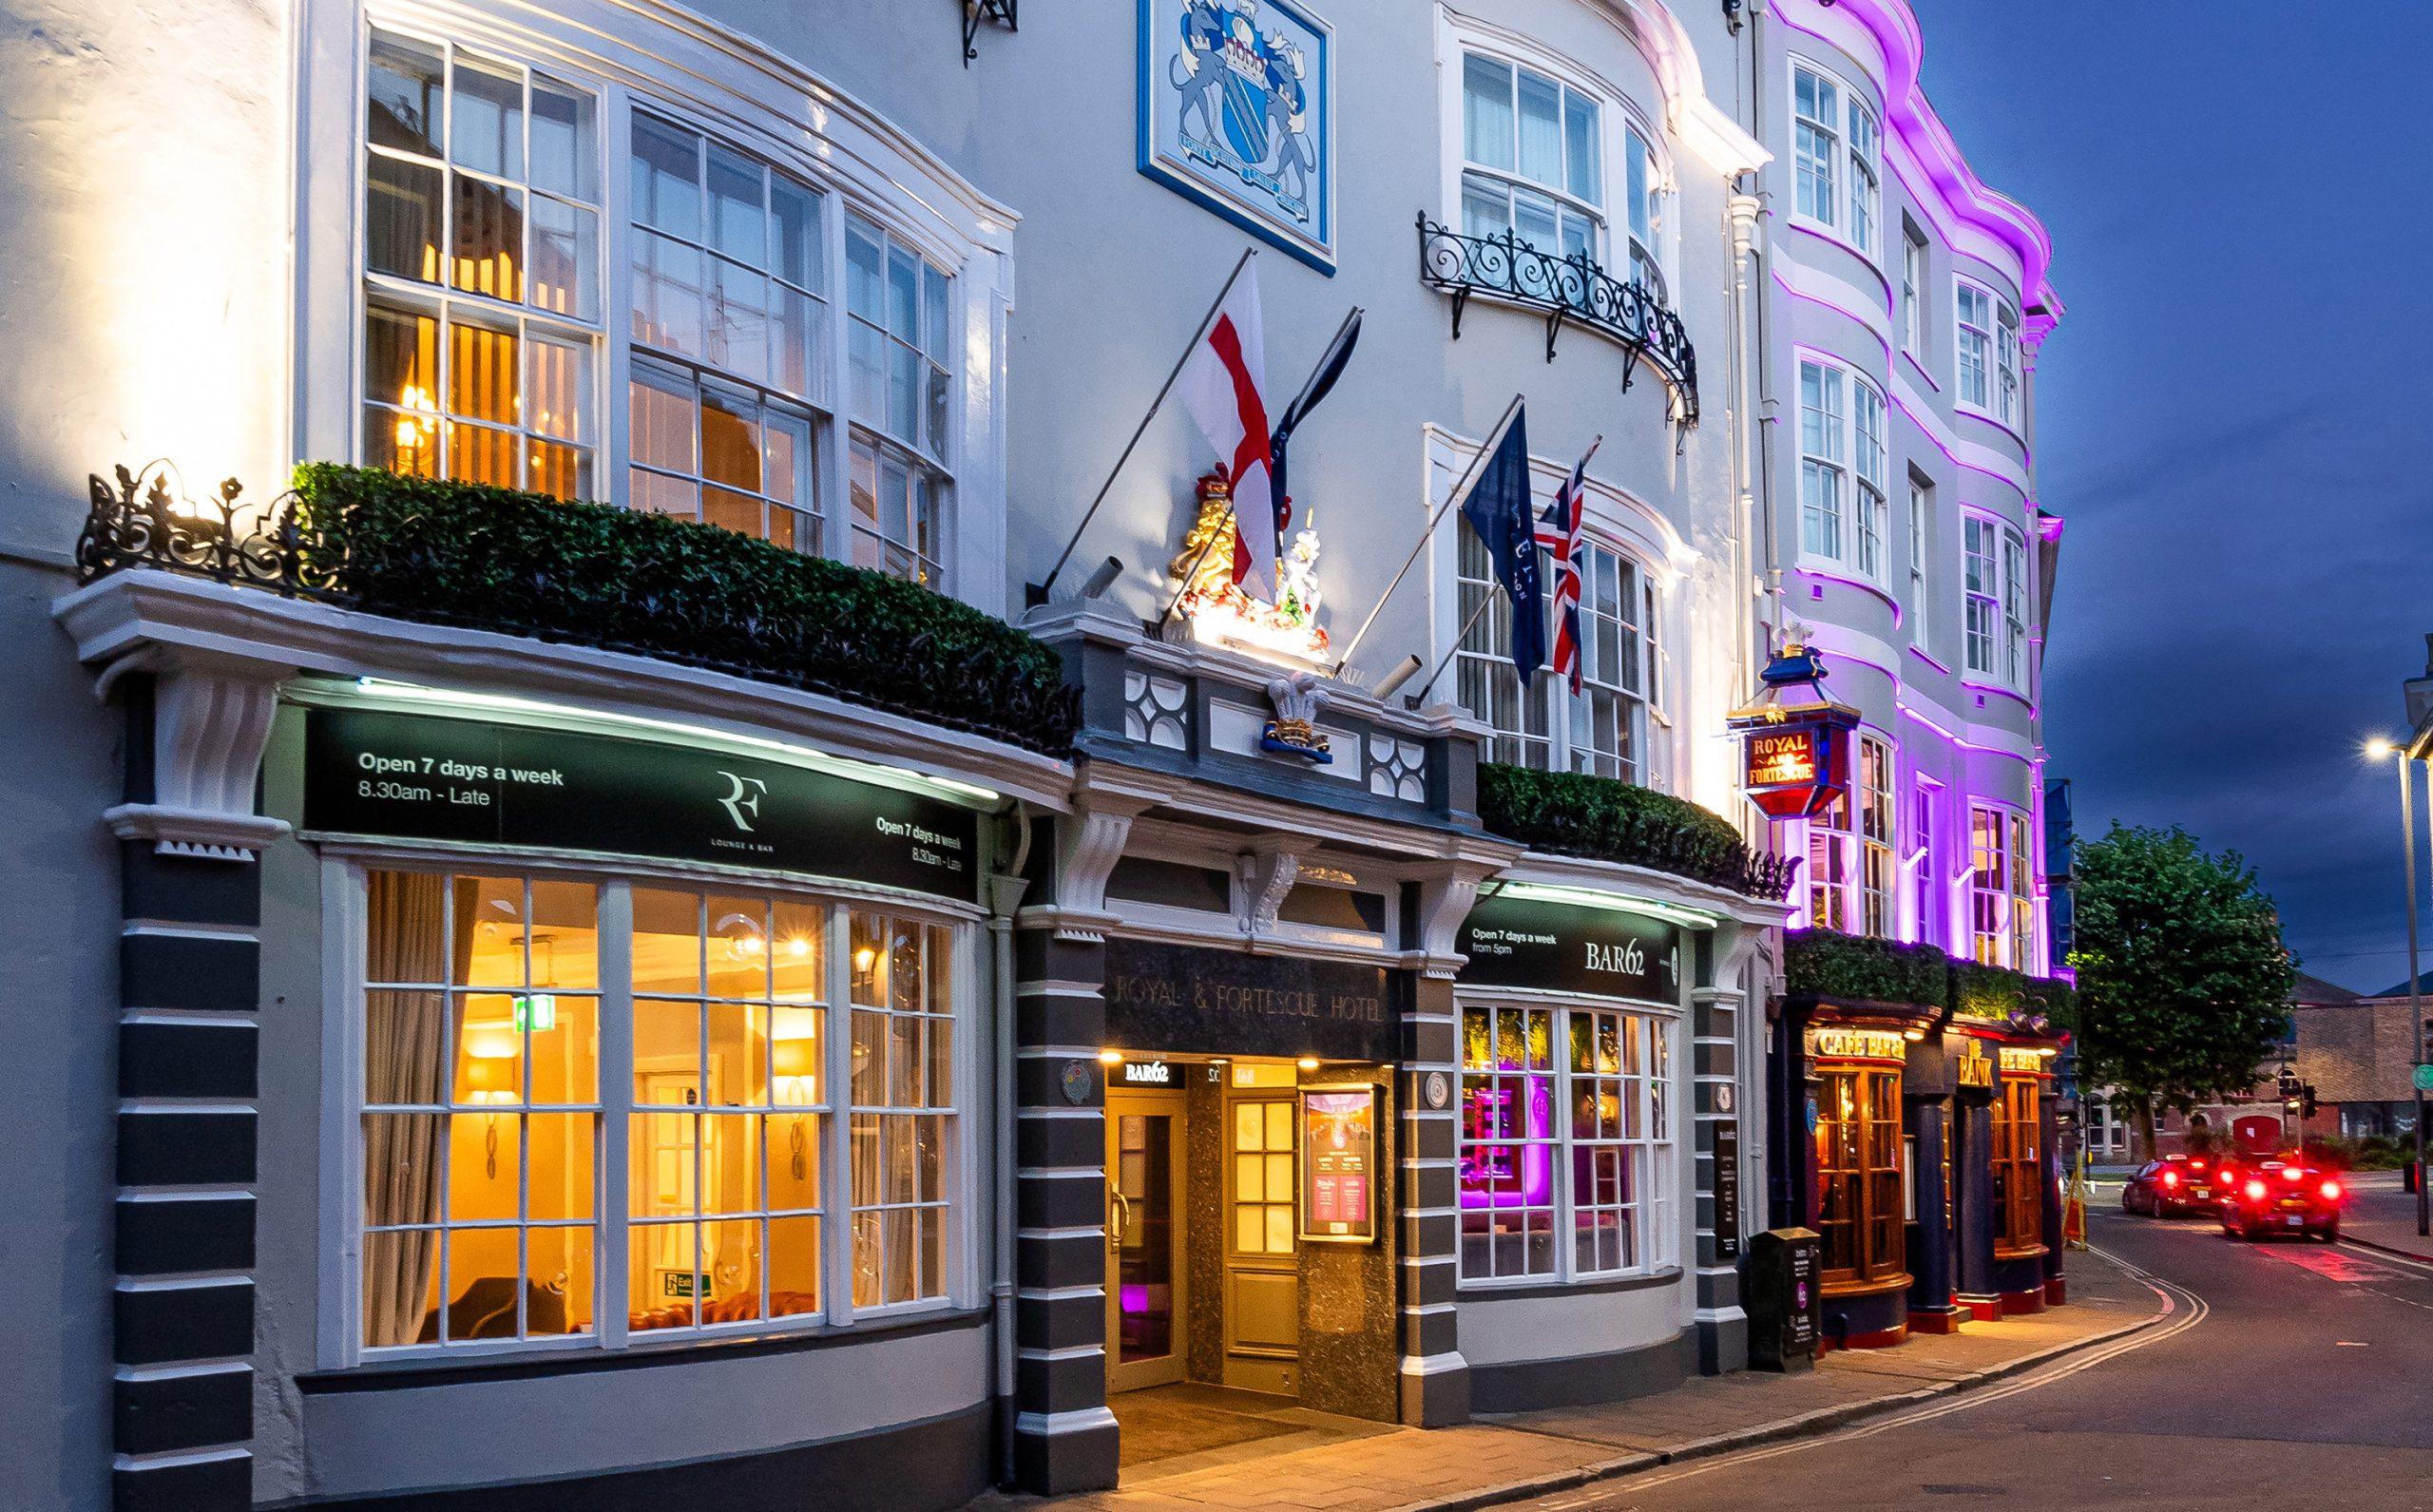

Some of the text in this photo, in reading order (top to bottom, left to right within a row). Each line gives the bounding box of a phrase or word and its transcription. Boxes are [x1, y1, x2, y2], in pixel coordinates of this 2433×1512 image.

[1753, 735, 1808, 755] ROYAL
[358, 753, 565, 786] Open 7 days a week
[1750, 763, 1813, 784] FORTESCUE
[358, 780, 431, 801] 8.30am
[450, 787, 490, 806] Late
[710, 837, 746, 850] LOUNGE
[757, 844, 774, 852] BAR
[876, 816, 962, 850] Open 7 days a week
[1472, 928, 1497, 940] Open
[1499, 930, 1504, 940] 7
[1506, 931, 1526, 944] days
[1535, 934, 1557, 945] week
[1472, 943, 1512, 955] from 5pm
[1584, 937, 1645, 976] BAR62
[1116, 975, 1384, 1023] ROYAL & FORTESCUE HOTEL
[1819, 1033, 1866, 1056] CAFE
[1125, 1061, 1169, 1082] BAR62
[1959, 1054, 1994, 1087] BANK
